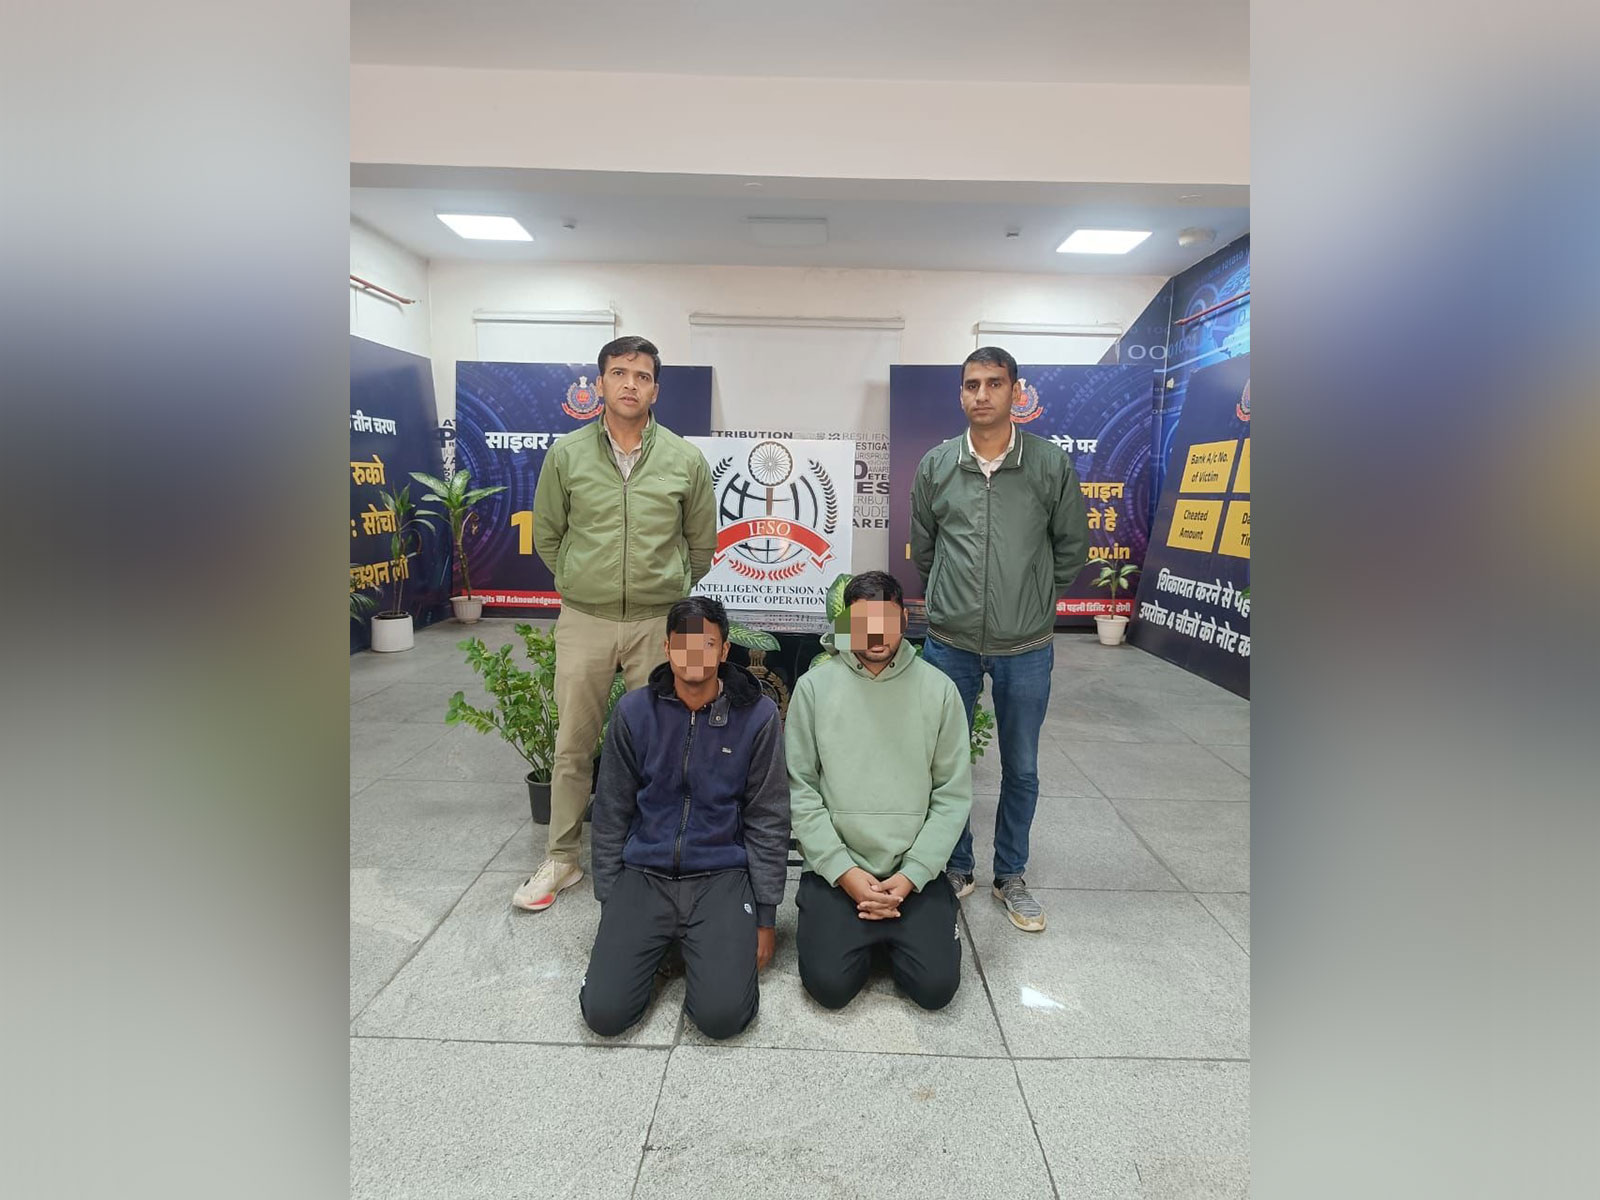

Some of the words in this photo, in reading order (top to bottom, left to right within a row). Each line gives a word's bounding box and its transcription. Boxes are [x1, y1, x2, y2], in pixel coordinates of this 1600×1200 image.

[373, 417, 397, 436] चरण
[712, 430, 794, 439] TRIBUTION
[485, 432, 550, 454] साइबर
[1076, 439, 1098, 453] पर
[1190, 453, 1205, 465] Bank
[1191, 471, 1199, 482] of
[1199, 470, 1219, 482] Victim
[1183, 509, 1209, 521] Cheated
[747, 522, 792, 537] IFSO
[1179, 527, 1204, 540] Amount
[1087, 543, 1131, 560] ov.in
[695, 583, 775, 594] INTELLIGENCE
[776, 585, 814, 595] FUSION
[1156, 567, 1196, 598] शिकायत
[1195, 578, 1222, 605] करने
[1221, 581, 1234, 609] से
[1166, 611, 1176, 629] 4
[1199, 616, 1217, 644] को
[1216, 621, 1239, 653] नोट
